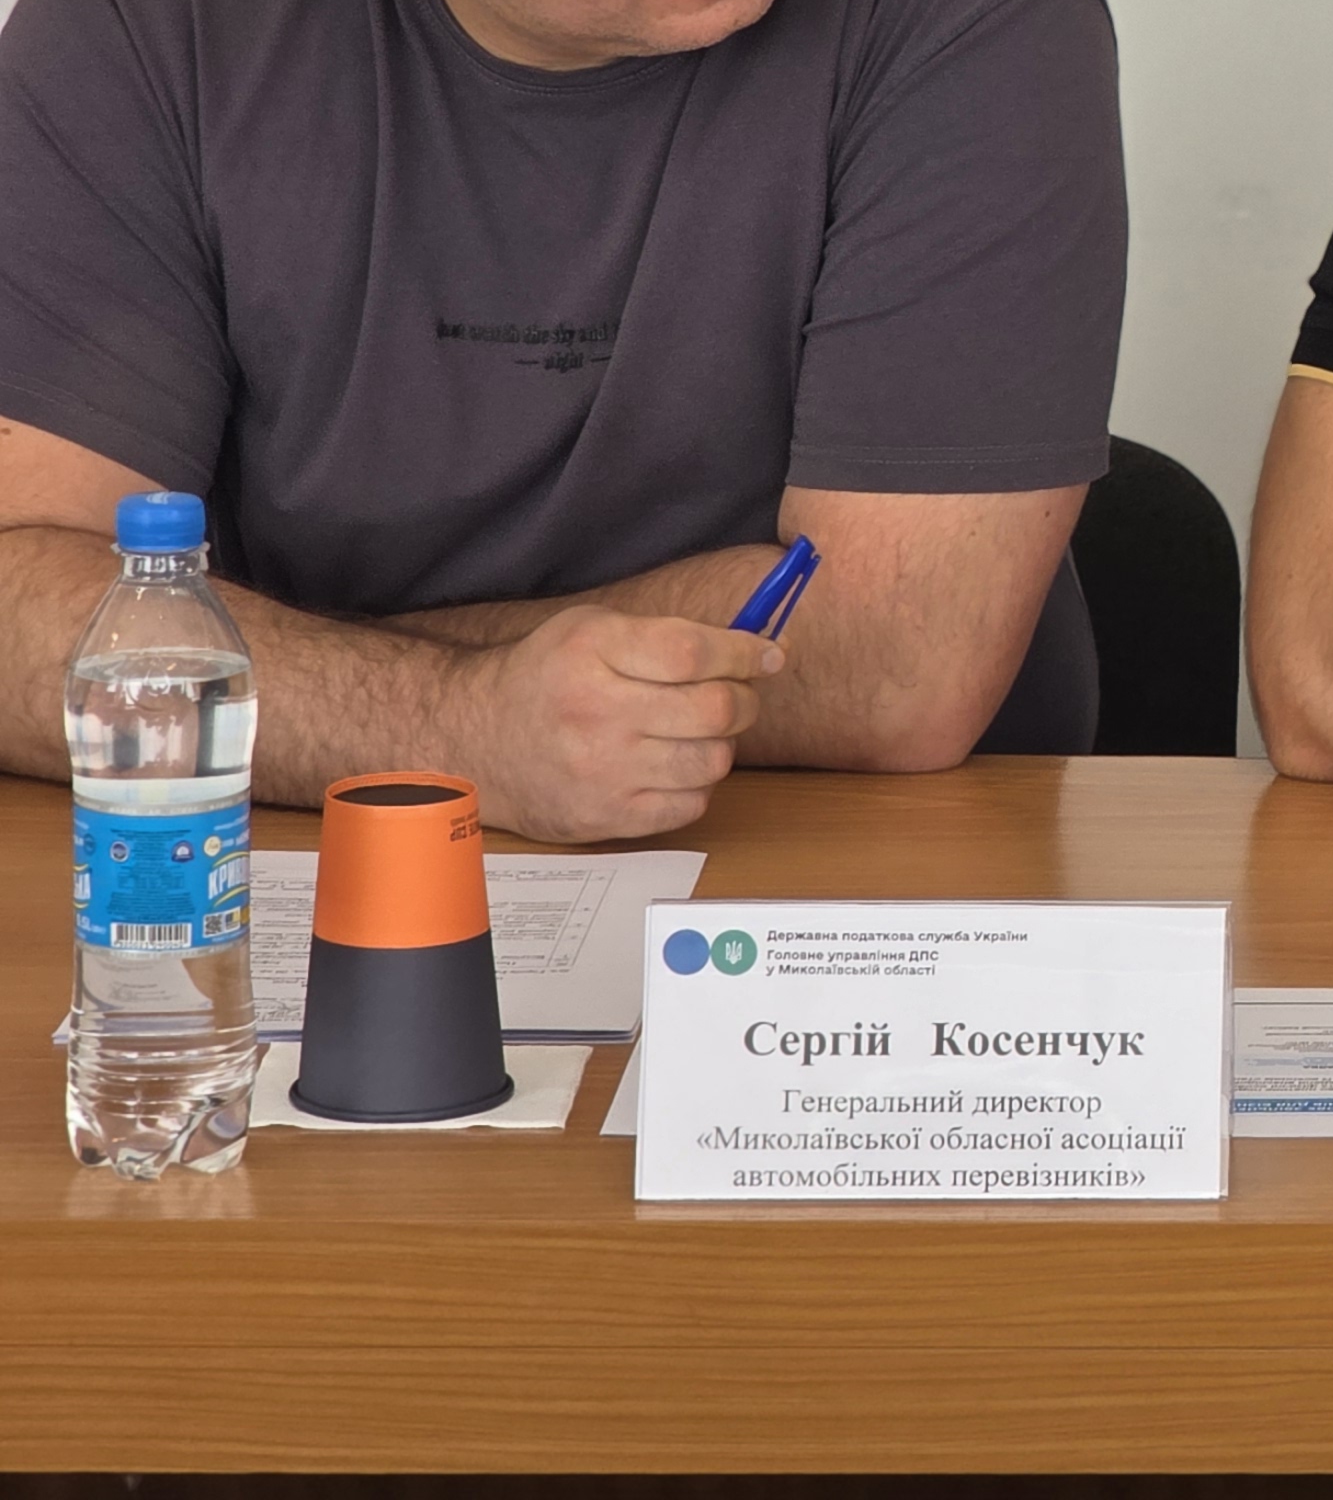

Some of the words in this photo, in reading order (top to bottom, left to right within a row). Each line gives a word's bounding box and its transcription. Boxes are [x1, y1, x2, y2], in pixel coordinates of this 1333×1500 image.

[766, 929, 839, 943] Державна
[841, 932, 915, 943] податкова
[917, 930, 970, 944] служба
[973, 930, 1028, 944] України
[766, 949, 825, 961] Головне
[827, 950, 906, 964] управління
[908, 950, 939, 963] ДПС
[778, 963, 881, 976] Миколаївській
[883, 964, 936, 976] області
[743, 1021, 891, 1063] Сергій
[931, 1022, 1145, 1063] Косенчук
[783, 1089, 964, 1120] Генеральний
[971, 1095, 1102, 1120] директор
[696, 1126, 923, 1150] «Миколаївської
[929, 1125, 1054, 1150] обласної
[1060, 1125, 1187, 1152] асоціації
[732, 1162, 941, 1187] автомобільних
[951, 1162, 1146, 1194] перевізників»
